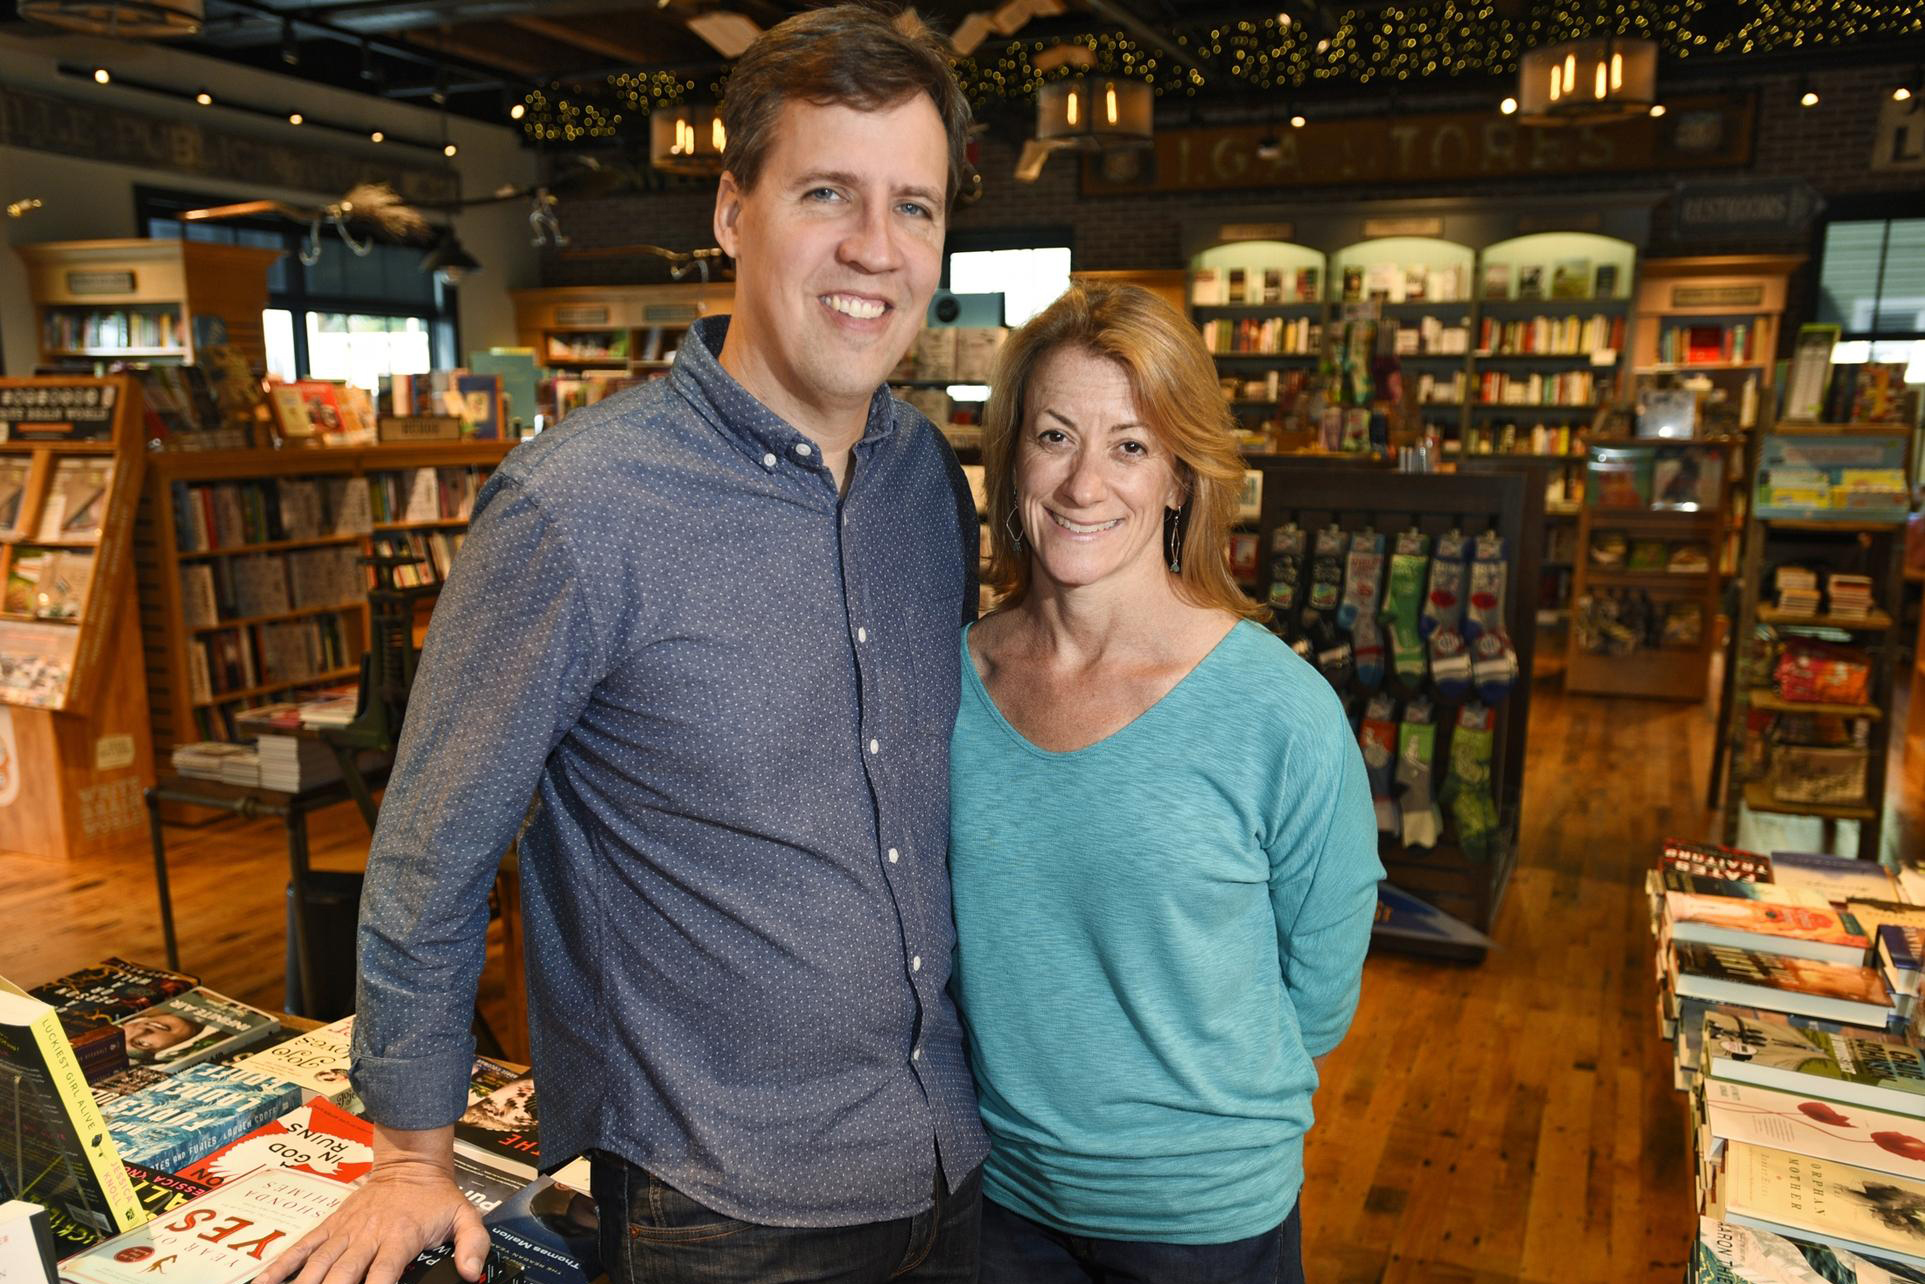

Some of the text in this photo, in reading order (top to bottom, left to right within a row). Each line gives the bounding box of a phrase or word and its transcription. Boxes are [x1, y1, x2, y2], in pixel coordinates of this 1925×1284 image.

[271, 1047, 336, 1069] Jojo
[41, 1018, 96, 1131] LUCKIEST GIRL ALIVE
[189, 1136, 217, 1156] FURIES
[286, 1121, 349, 1153] RUINS
[268, 1142, 345, 1166] IN GOD
[103, 1171, 121, 1208] KNOLL
[110, 1160, 133, 1204] JESSICA
[153, 1175, 206, 1198] ESSICA
[263, 1181, 341, 1208] RHIMES
[1788, 1157, 1802, 1211] MOTHER
[1810, 1162, 1826, 1217] ORPHAN
[243, 1189, 330, 1218] SHONDA
[164, 1208, 287, 1261] YES
[491, 1226, 535, 1250] Mallon
[532, 1244, 581, 1271] Thomas
[183, 1243, 240, 1269] YEAR
